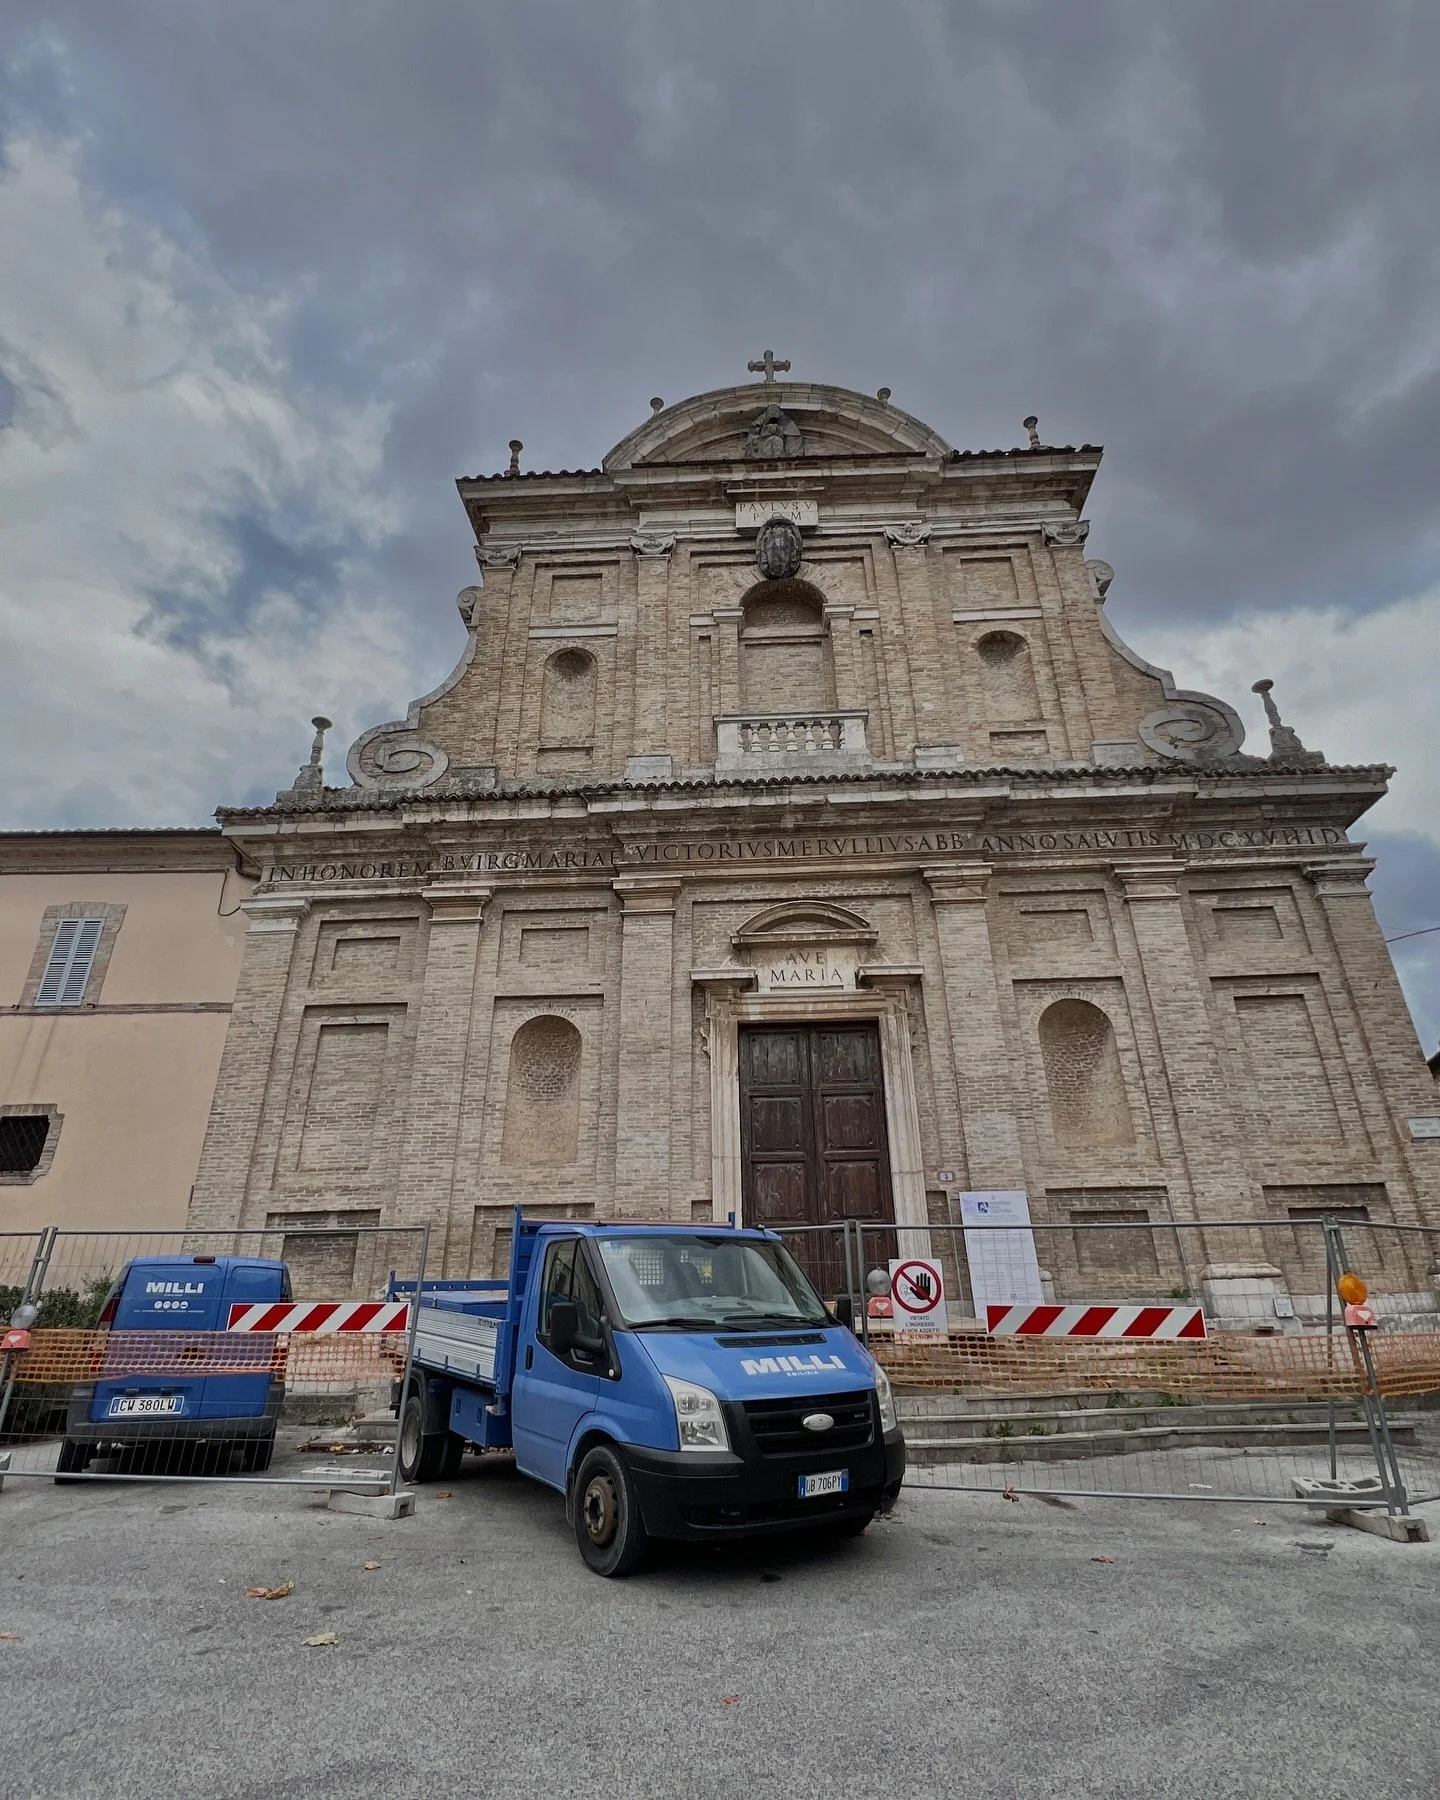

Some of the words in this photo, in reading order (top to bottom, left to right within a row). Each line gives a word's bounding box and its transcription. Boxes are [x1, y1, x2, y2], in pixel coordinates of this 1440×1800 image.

[740, 502, 799, 512] PAVLVS
[786, 952, 825, 965] AVE
[770, 968, 843, 983] MARIA
[146, 1281, 204, 1294] MILLI
[740, 1355, 847, 1376] MILLI
